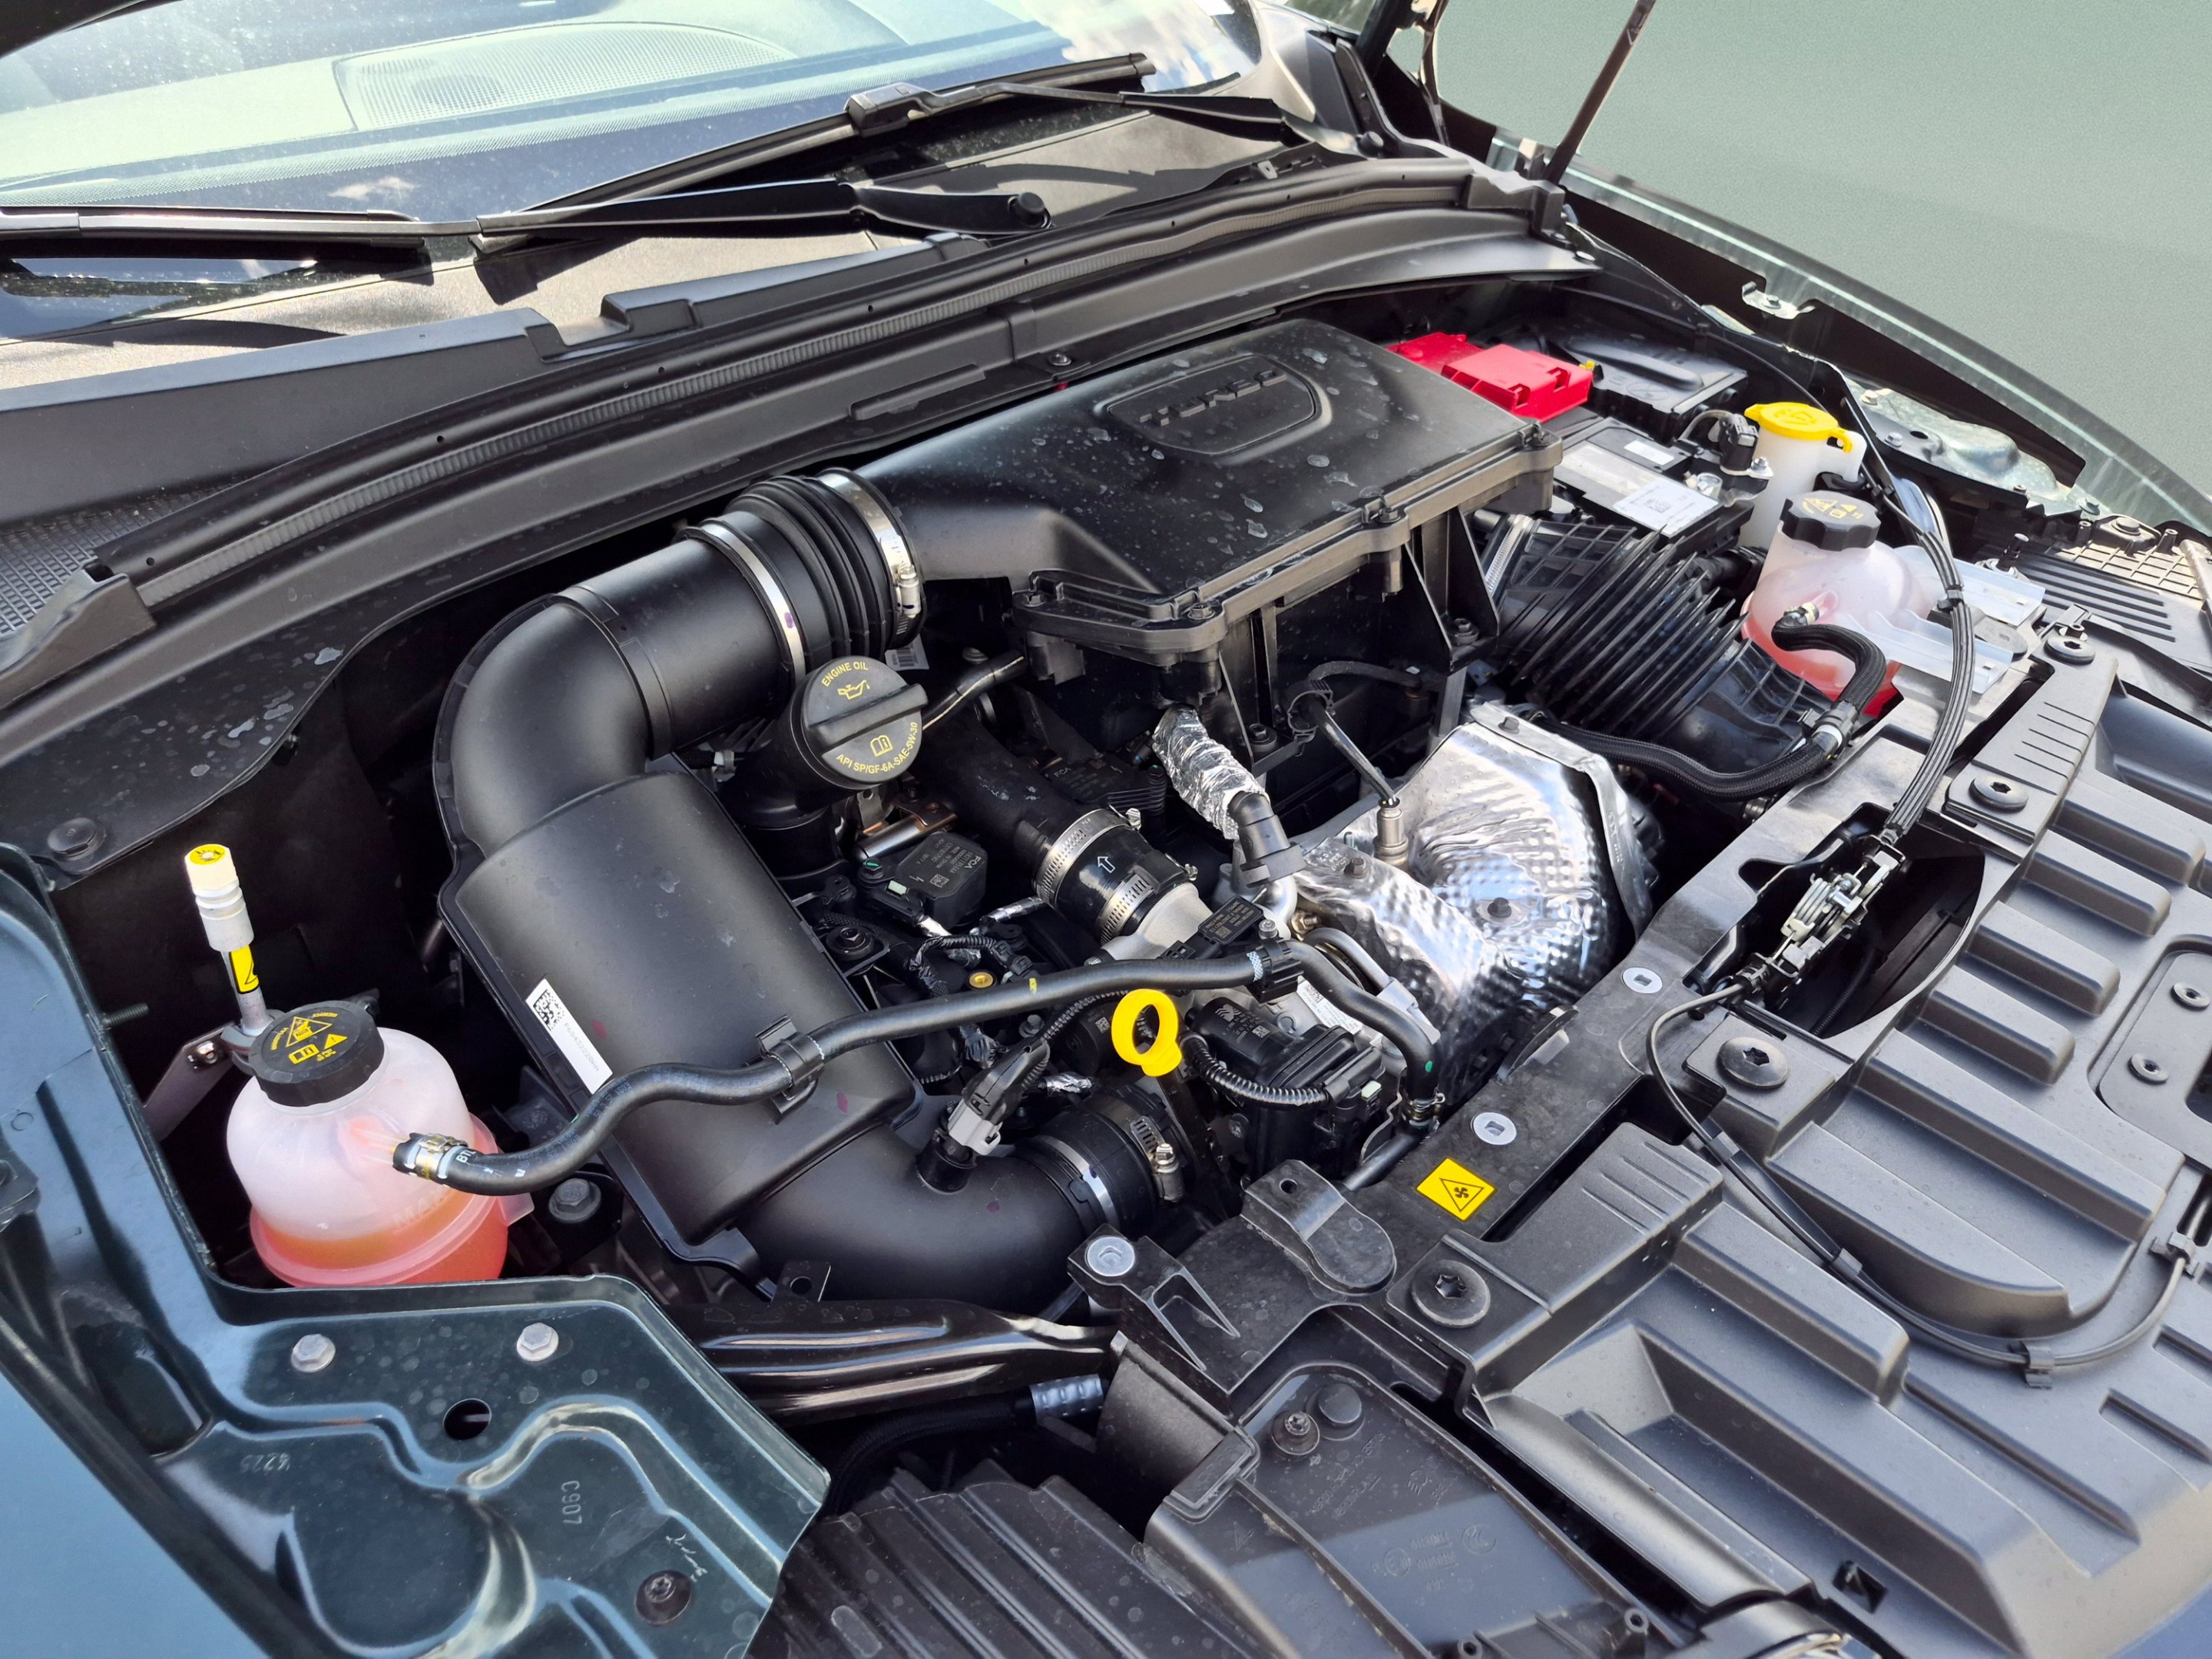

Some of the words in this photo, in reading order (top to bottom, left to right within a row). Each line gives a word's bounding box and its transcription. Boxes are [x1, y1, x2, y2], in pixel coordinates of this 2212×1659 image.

[1140, 369, 1287, 427] TURBO
[821, 662, 852, 687] ENGINE
[853, 661, 869, 671] OIL
[836, 753, 853, 768] API
[853, 722, 918, 774] SP/GF-6A-SAE-5W-30
[456, 1150, 476, 1163] BTL
[561, 1481, 582, 1525] C907
